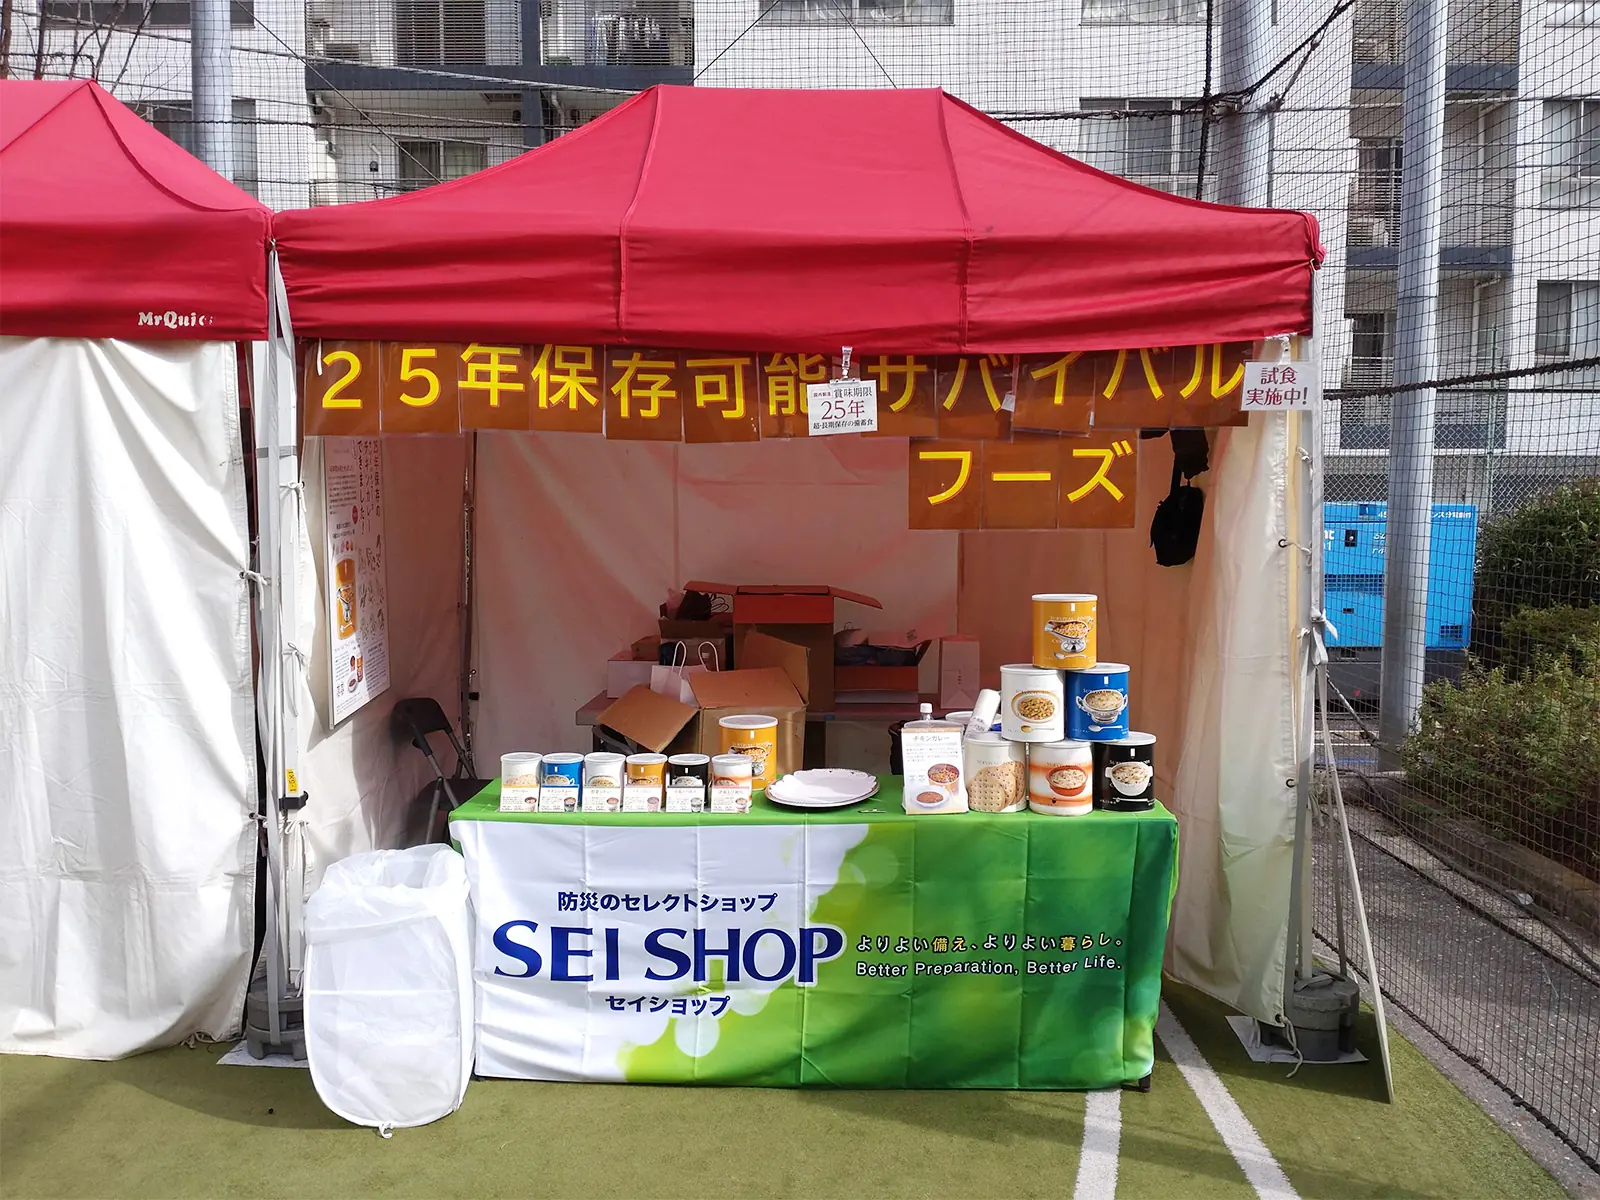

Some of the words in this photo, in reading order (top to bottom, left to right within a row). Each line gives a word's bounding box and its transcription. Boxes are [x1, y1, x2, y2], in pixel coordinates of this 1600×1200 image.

[138, 311, 214, 329] MrQuic
[1260, 366, 1298, 385] 試食
[834, 386, 873, 399] 賞味期限
[820, 399, 866, 420] 25年
[919, 440, 1135, 505] フーズ
[557, 891, 779, 913] 防災のセレクトショップ
[492, 919, 620, 982] SEI
[643, 926, 845, 984] SHOP
[856, 932, 1124, 953] よりよい備え、よりよい暮らし。
[856, 961, 908, 977] Better
[915, 959, 1019, 977] Preparation,
[1026, 960, 1078, 975] Better
[1083, 954, 1122, 971] Life.
[604, 995, 731, 1017] セイショップ
